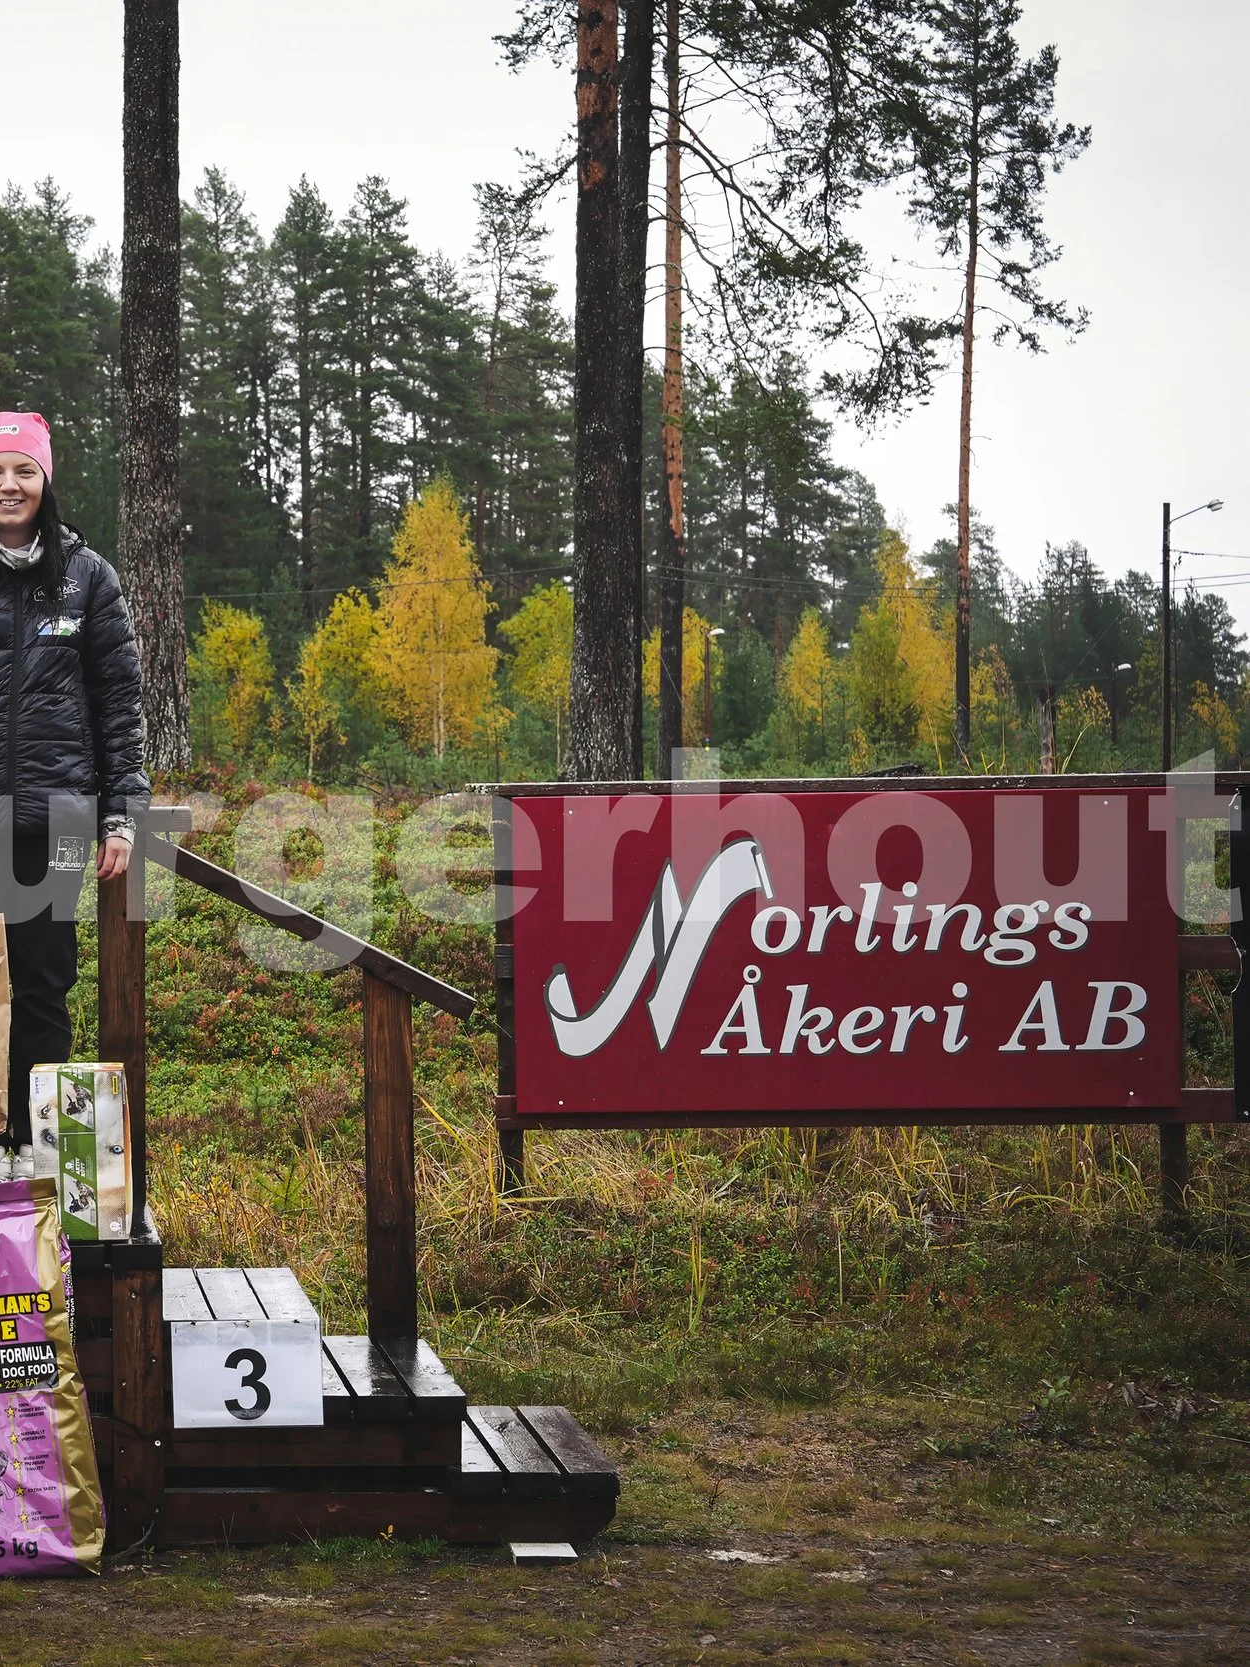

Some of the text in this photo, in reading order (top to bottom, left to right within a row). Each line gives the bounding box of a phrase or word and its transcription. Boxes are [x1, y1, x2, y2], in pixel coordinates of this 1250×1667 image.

[545, 838, 1092, 1058] Norlings
[701, 966, 1149, 1056] Åkeri AB
[0, 1345, 54, 1364] FORMULA
[2, 1366, 25, 1378] DOG
[27, 1363, 55, 1376] FOOD
[5, 1379, 23, 1389] 22%
[25, 1378, 39, 1387] FAT
[224, 1348, 271, 1421] 3
[12, 1538, 38, 1560] kg
